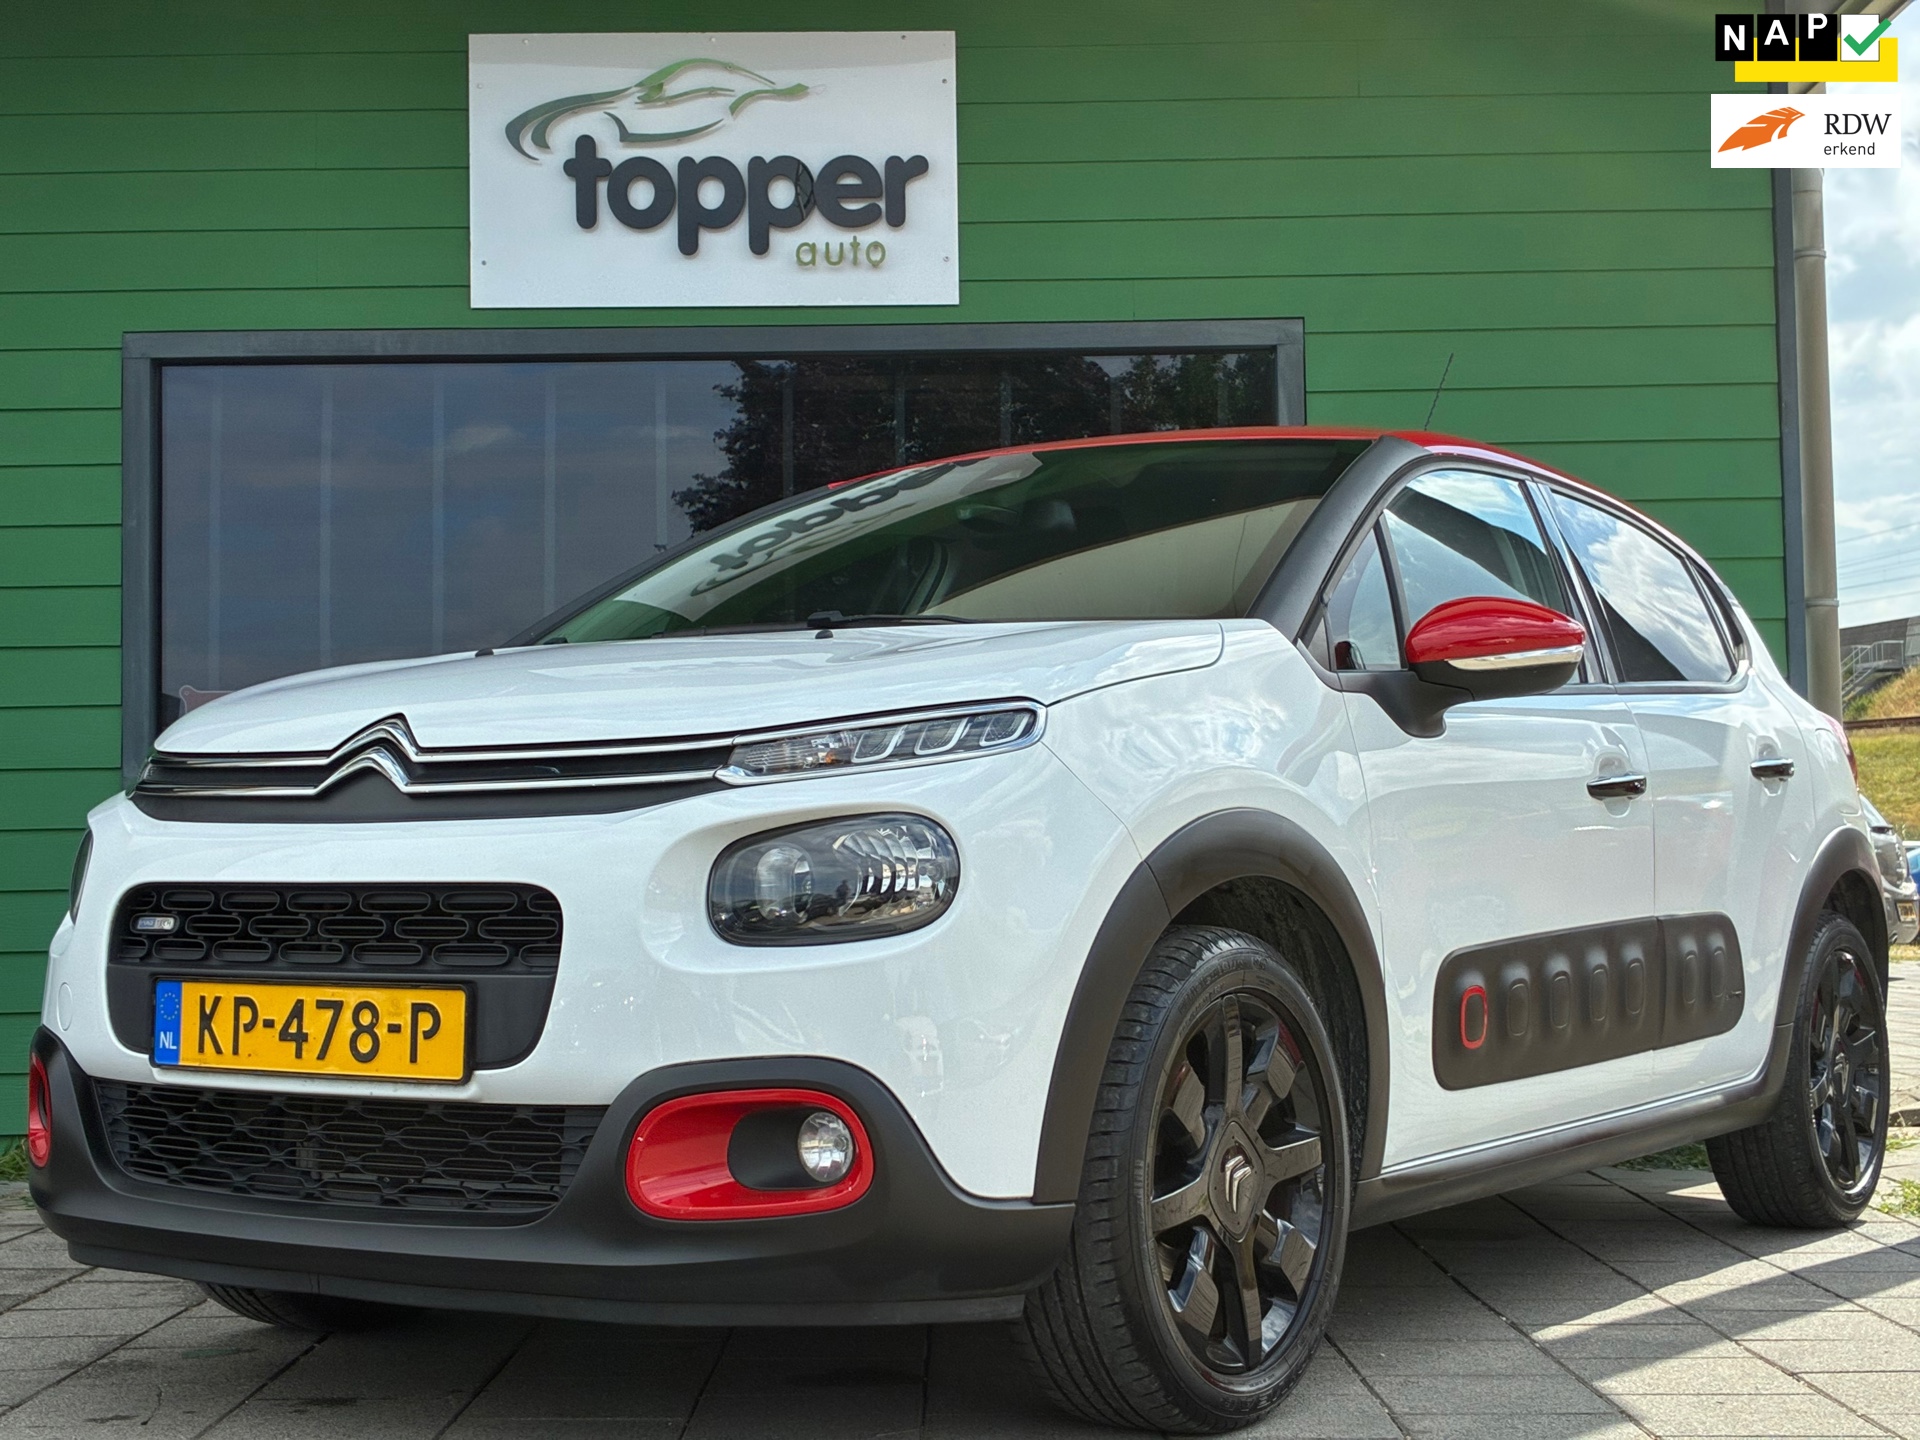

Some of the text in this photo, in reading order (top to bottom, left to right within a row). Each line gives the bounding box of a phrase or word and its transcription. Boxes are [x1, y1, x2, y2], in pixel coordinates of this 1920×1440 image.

[563, 134, 929, 256] topper
[796, 236, 886, 267] auto
[159, 1031, 177, 1050] NL
[197, 994, 442, 1064] KP-478-P
